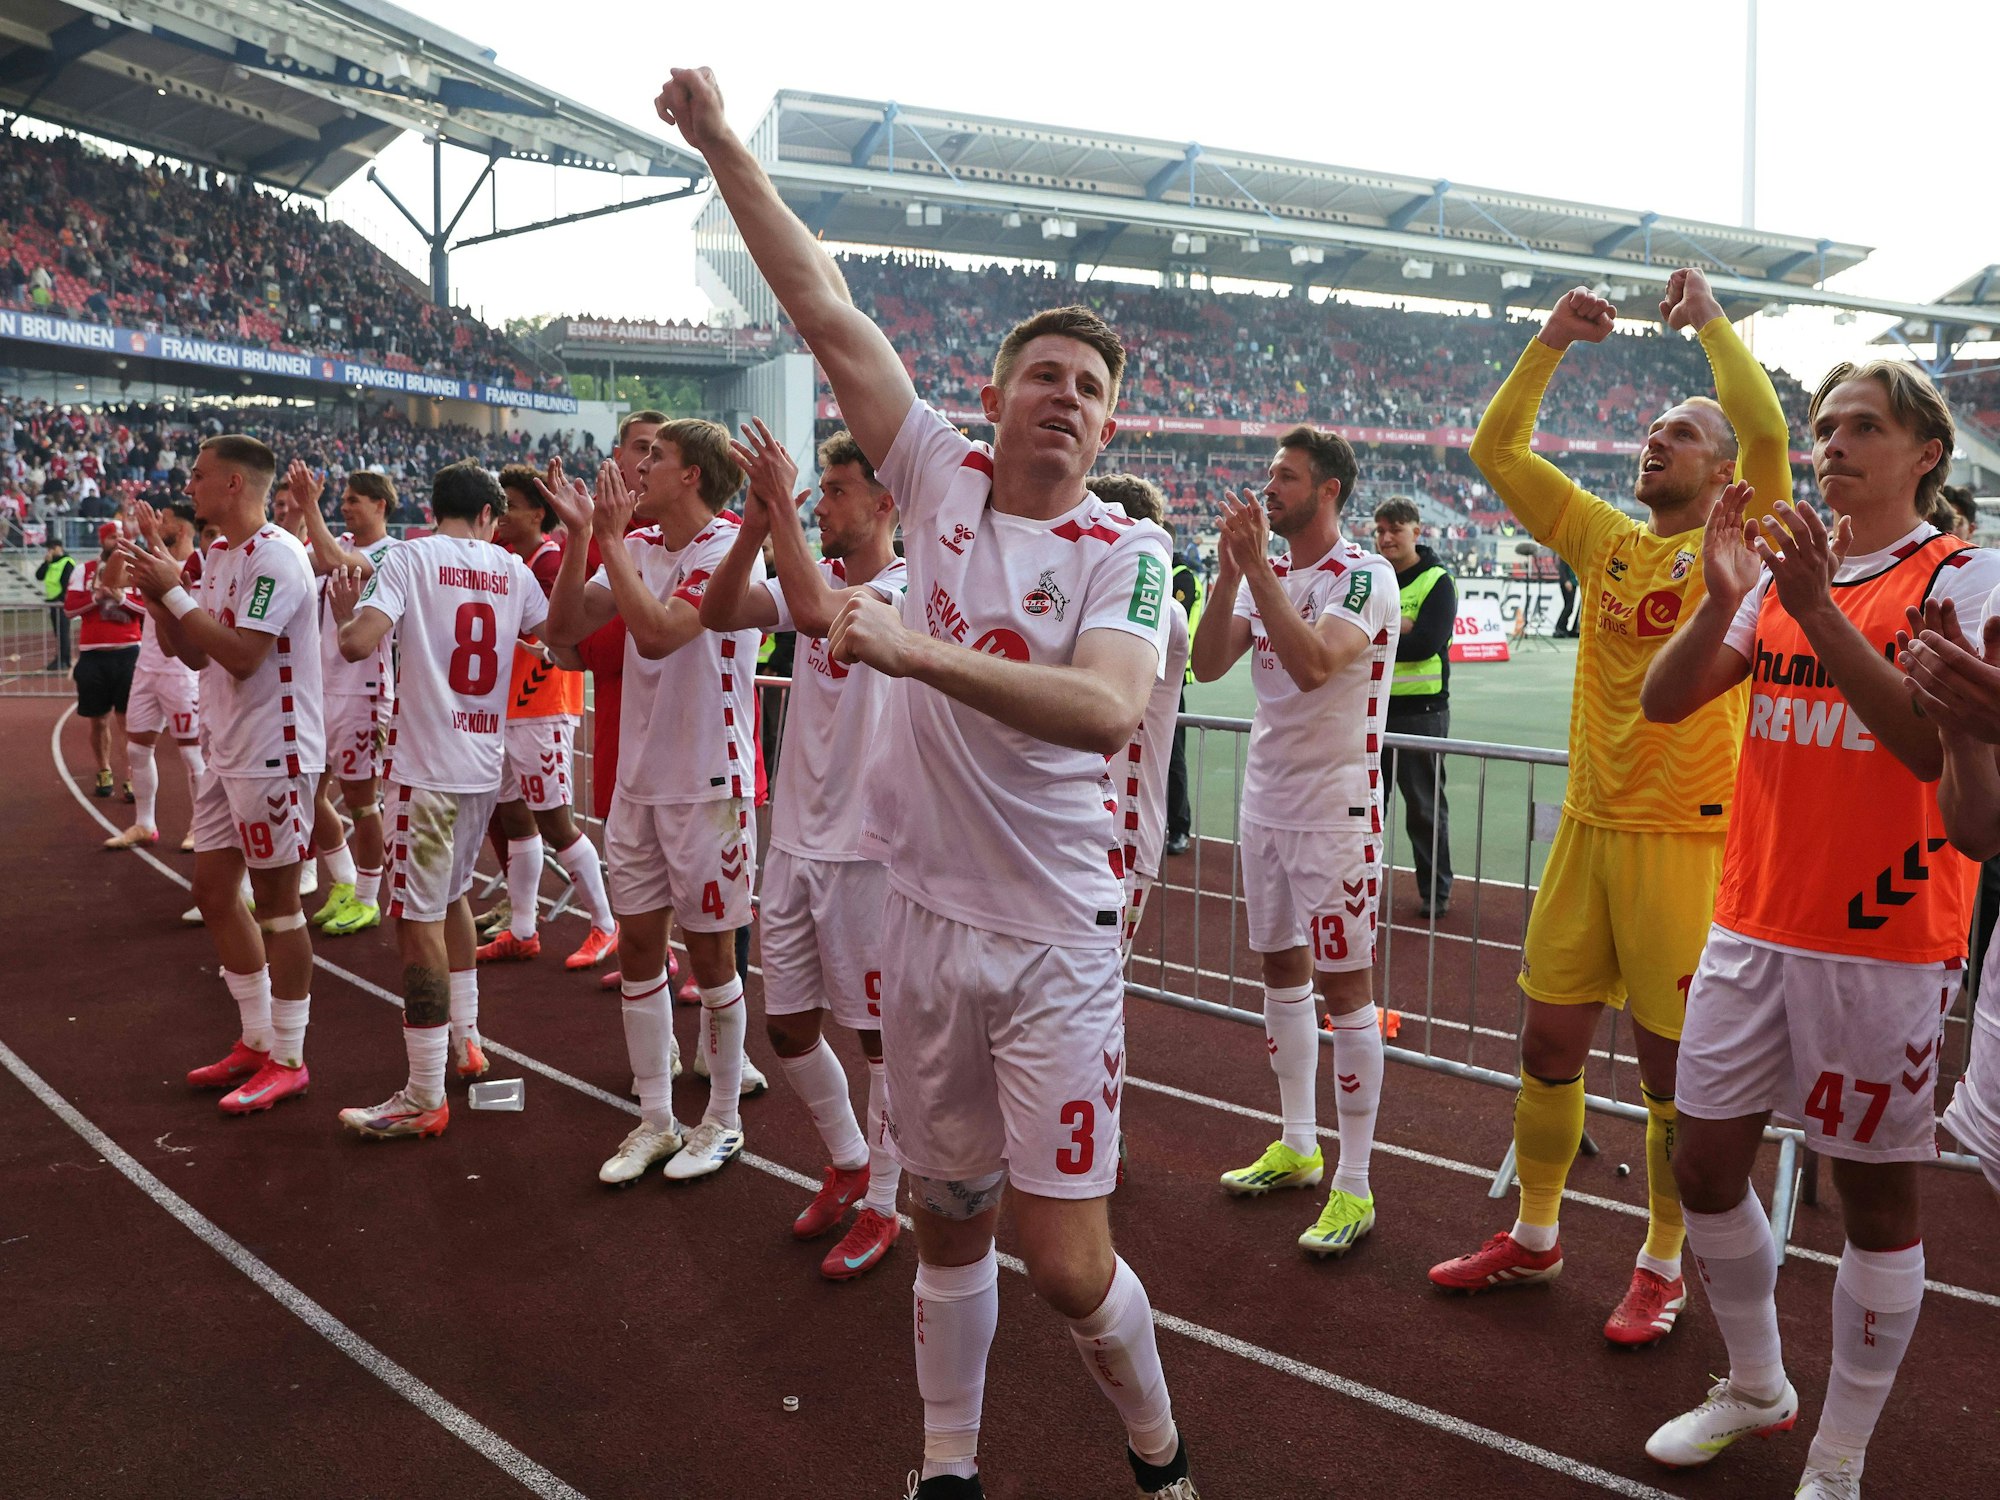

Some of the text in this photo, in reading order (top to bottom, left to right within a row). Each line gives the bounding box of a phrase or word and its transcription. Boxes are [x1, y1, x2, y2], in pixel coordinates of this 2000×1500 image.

[22, 315, 115, 349] BRUNNEN
[567, 322, 730, 344] ESW-FAMILIENBLOCK
[161, 338, 311, 376] FRANKEN BRUNNEN
[344, 364, 460, 397] FRANKEN BRUNNEN
[486, 386, 577, 414] FRANKEN BRUNNEN
[939, 534, 965, 556] hummel
[251, 581, 272, 617] DEVK
[1136, 560, 1161, 622] DEVK
[931, 580, 970, 644] REWE
[1454, 616, 1500, 635] BS.de
[448, 602, 499, 696] 8
[173, 713, 192, 733] 17
[468, 709, 499, 734] KÖLN
[1750, 693, 1876, 752] REWE
[342, 750, 357, 774] 2
[521, 774, 545, 804] 49
[239, 822, 274, 859] 19
[701, 880, 725, 920] 4
[1310, 915, 1348, 960] 13
[1804, 1071, 1892, 1144] 47
[1056, 1100, 1095, 1175] 3
